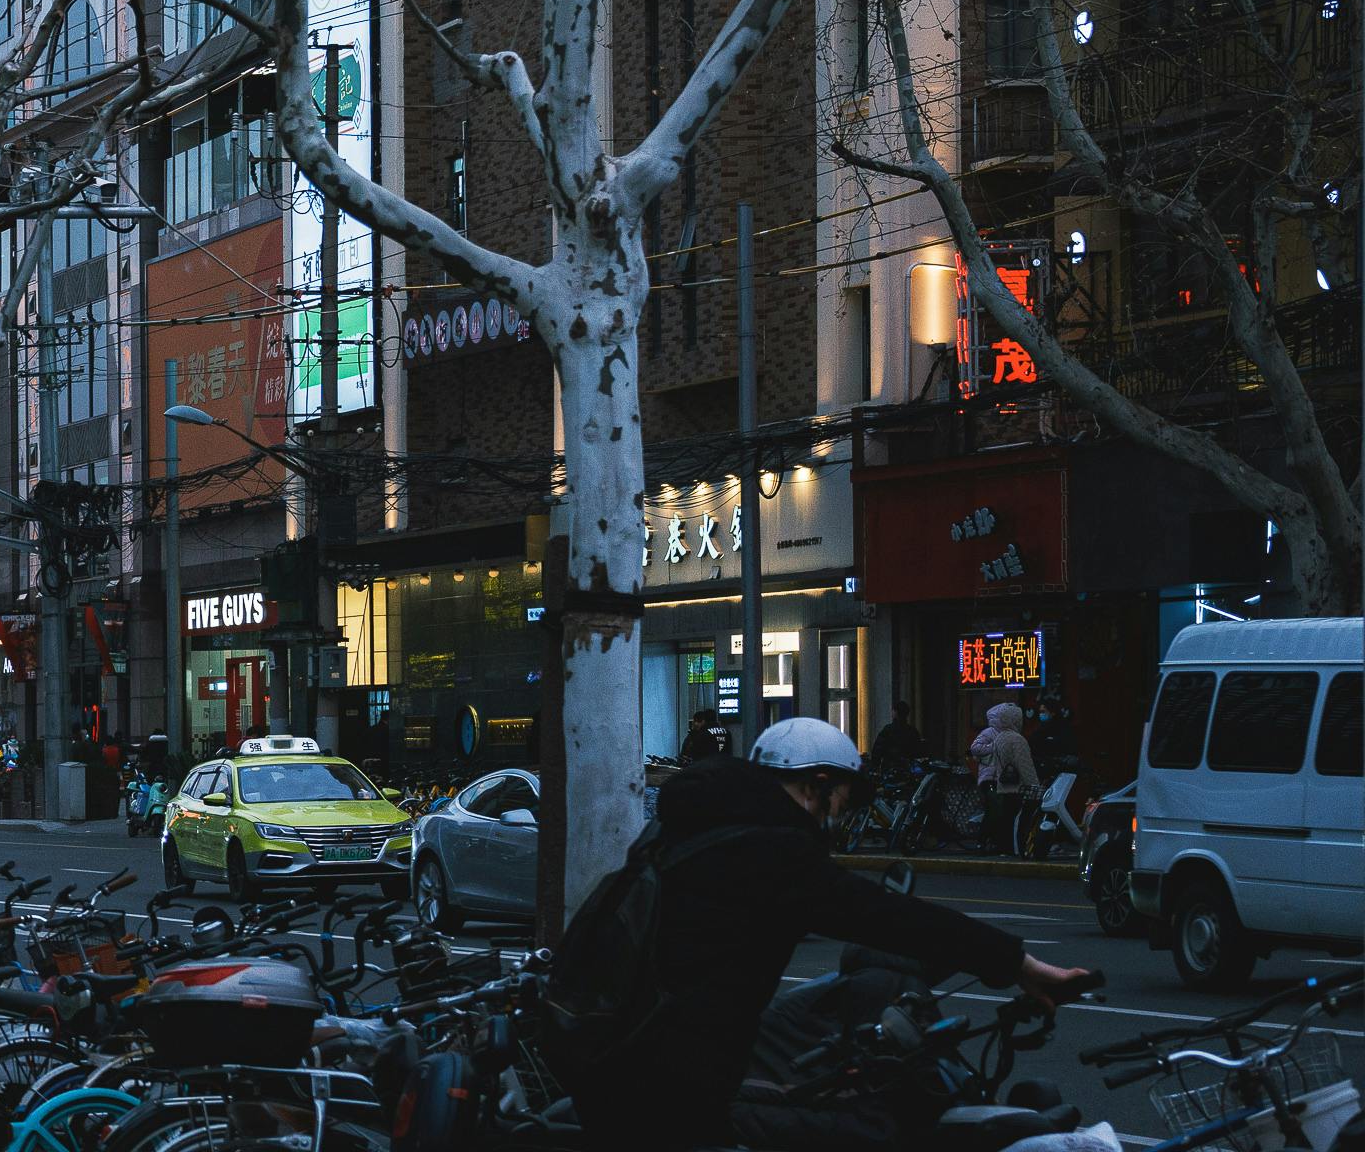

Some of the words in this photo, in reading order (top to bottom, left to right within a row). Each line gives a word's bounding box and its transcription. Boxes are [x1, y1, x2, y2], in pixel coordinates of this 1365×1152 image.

[187, 598, 220, 630] FIVE
[222, 592, 265, 627] GUYS
[249, 741, 263, 754] 强
[301, 741, 315, 752] 生
